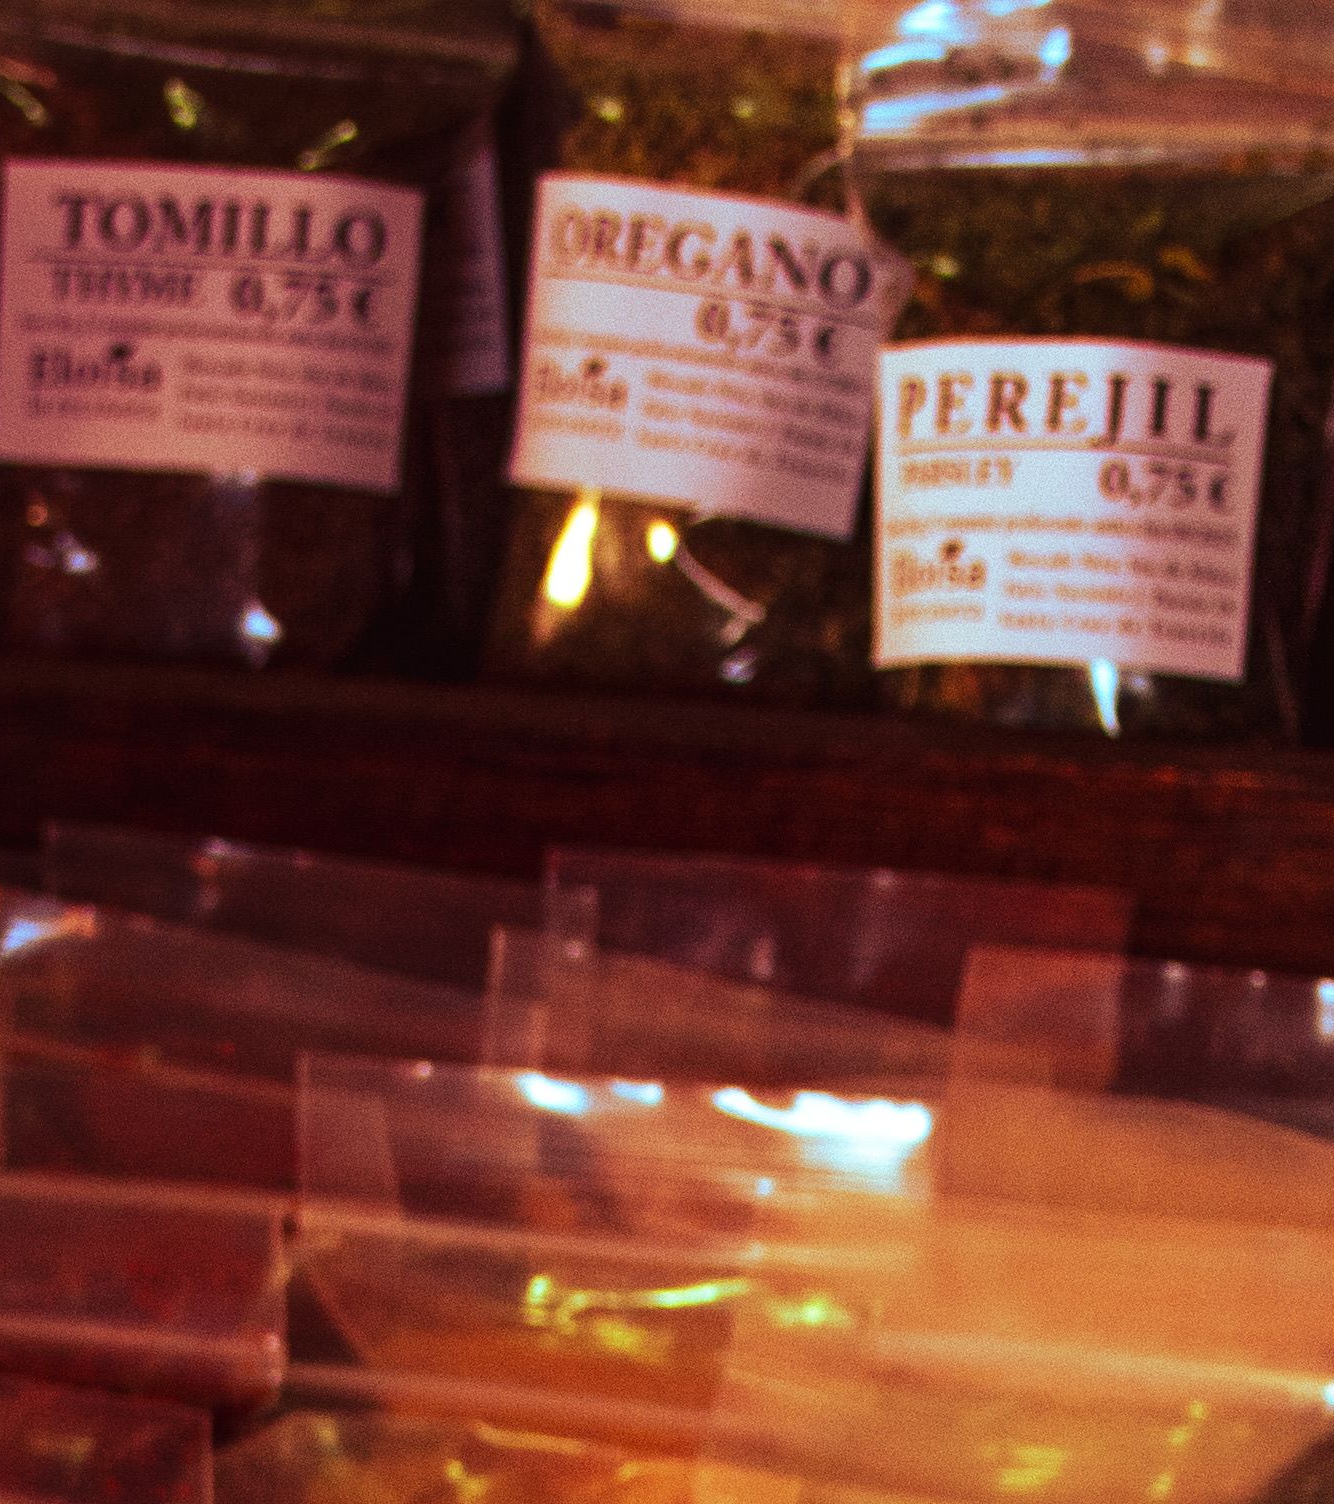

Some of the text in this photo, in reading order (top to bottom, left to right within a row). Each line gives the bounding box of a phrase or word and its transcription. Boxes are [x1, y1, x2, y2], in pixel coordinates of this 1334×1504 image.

[52, 189, 390, 269] TOMILLO
[551, 207, 872, 312] OREGANO
[897, 369, 1238, 449] PEREJIL
[1097, 465, 1203, 511] 0,75
